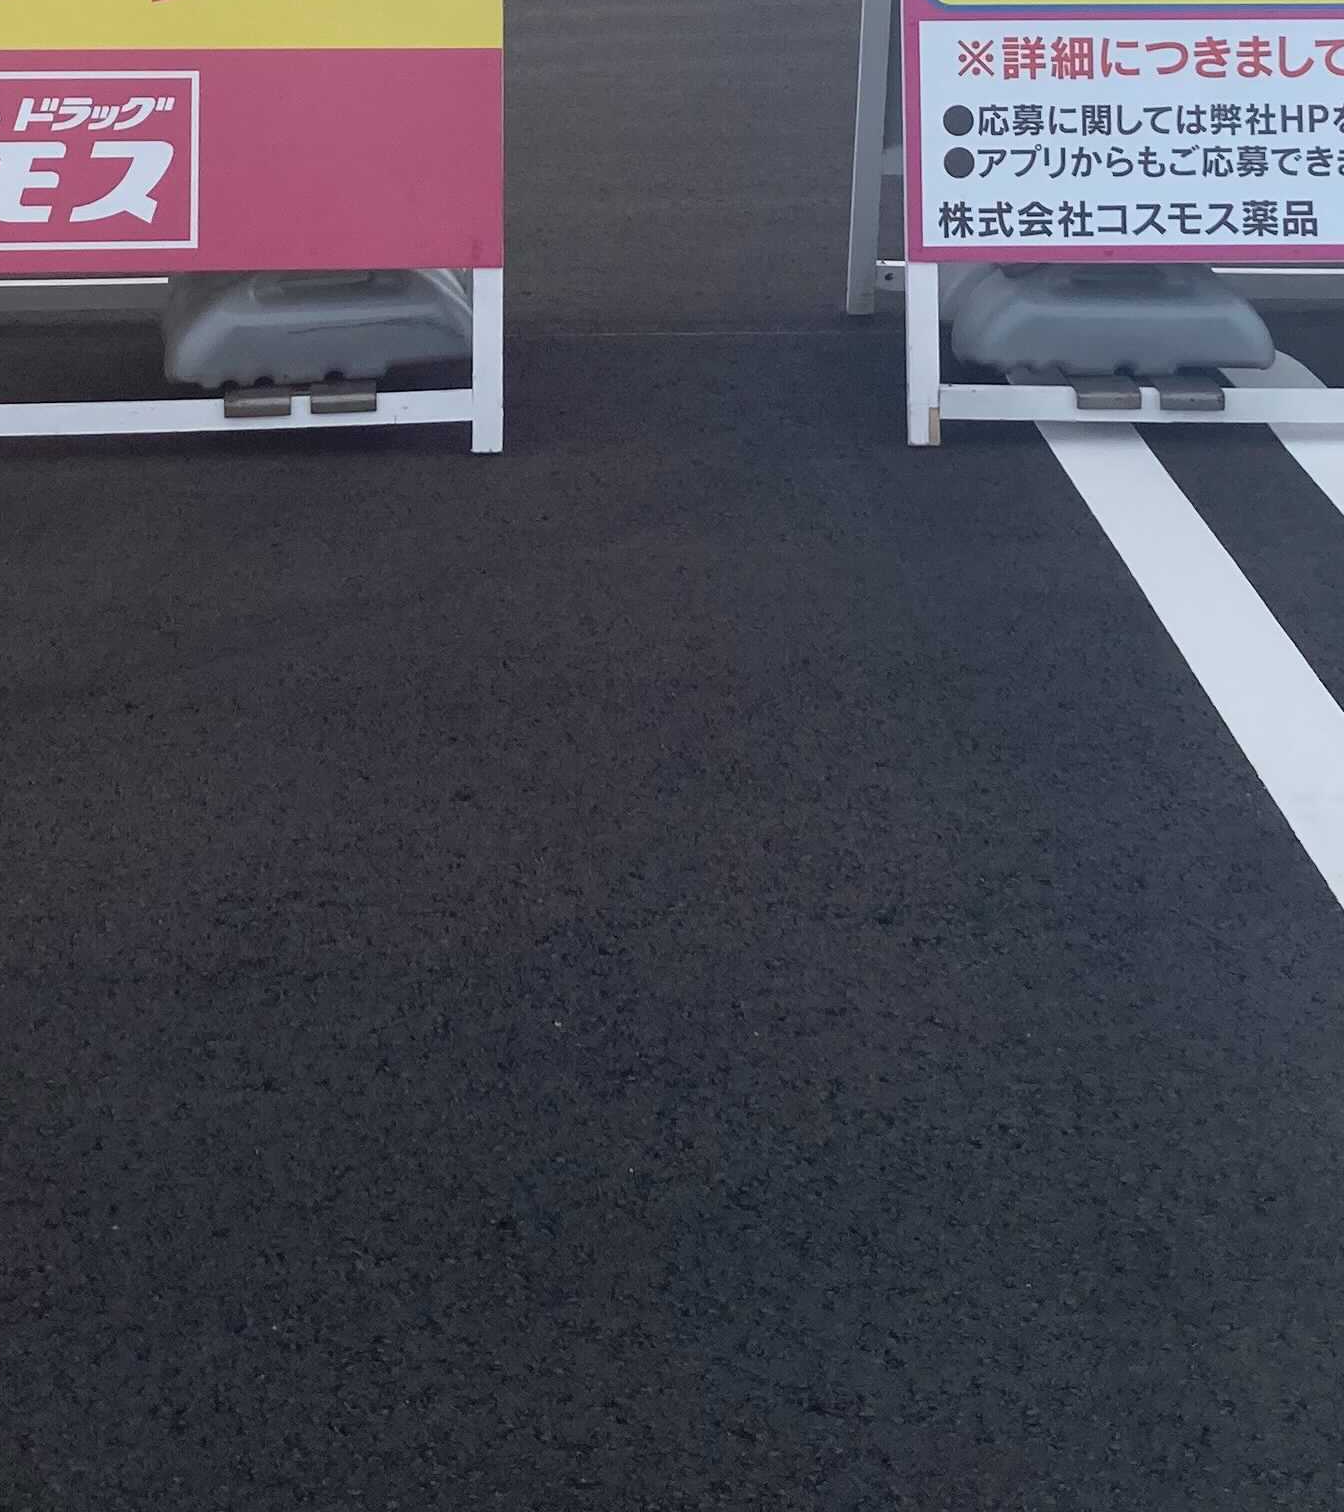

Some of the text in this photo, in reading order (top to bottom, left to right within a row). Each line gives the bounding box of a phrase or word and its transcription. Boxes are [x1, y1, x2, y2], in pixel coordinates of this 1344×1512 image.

[13, 96, 175, 132] ドラッグ
[937, 199, 1319, 239] 株式会社コスモス薬品
